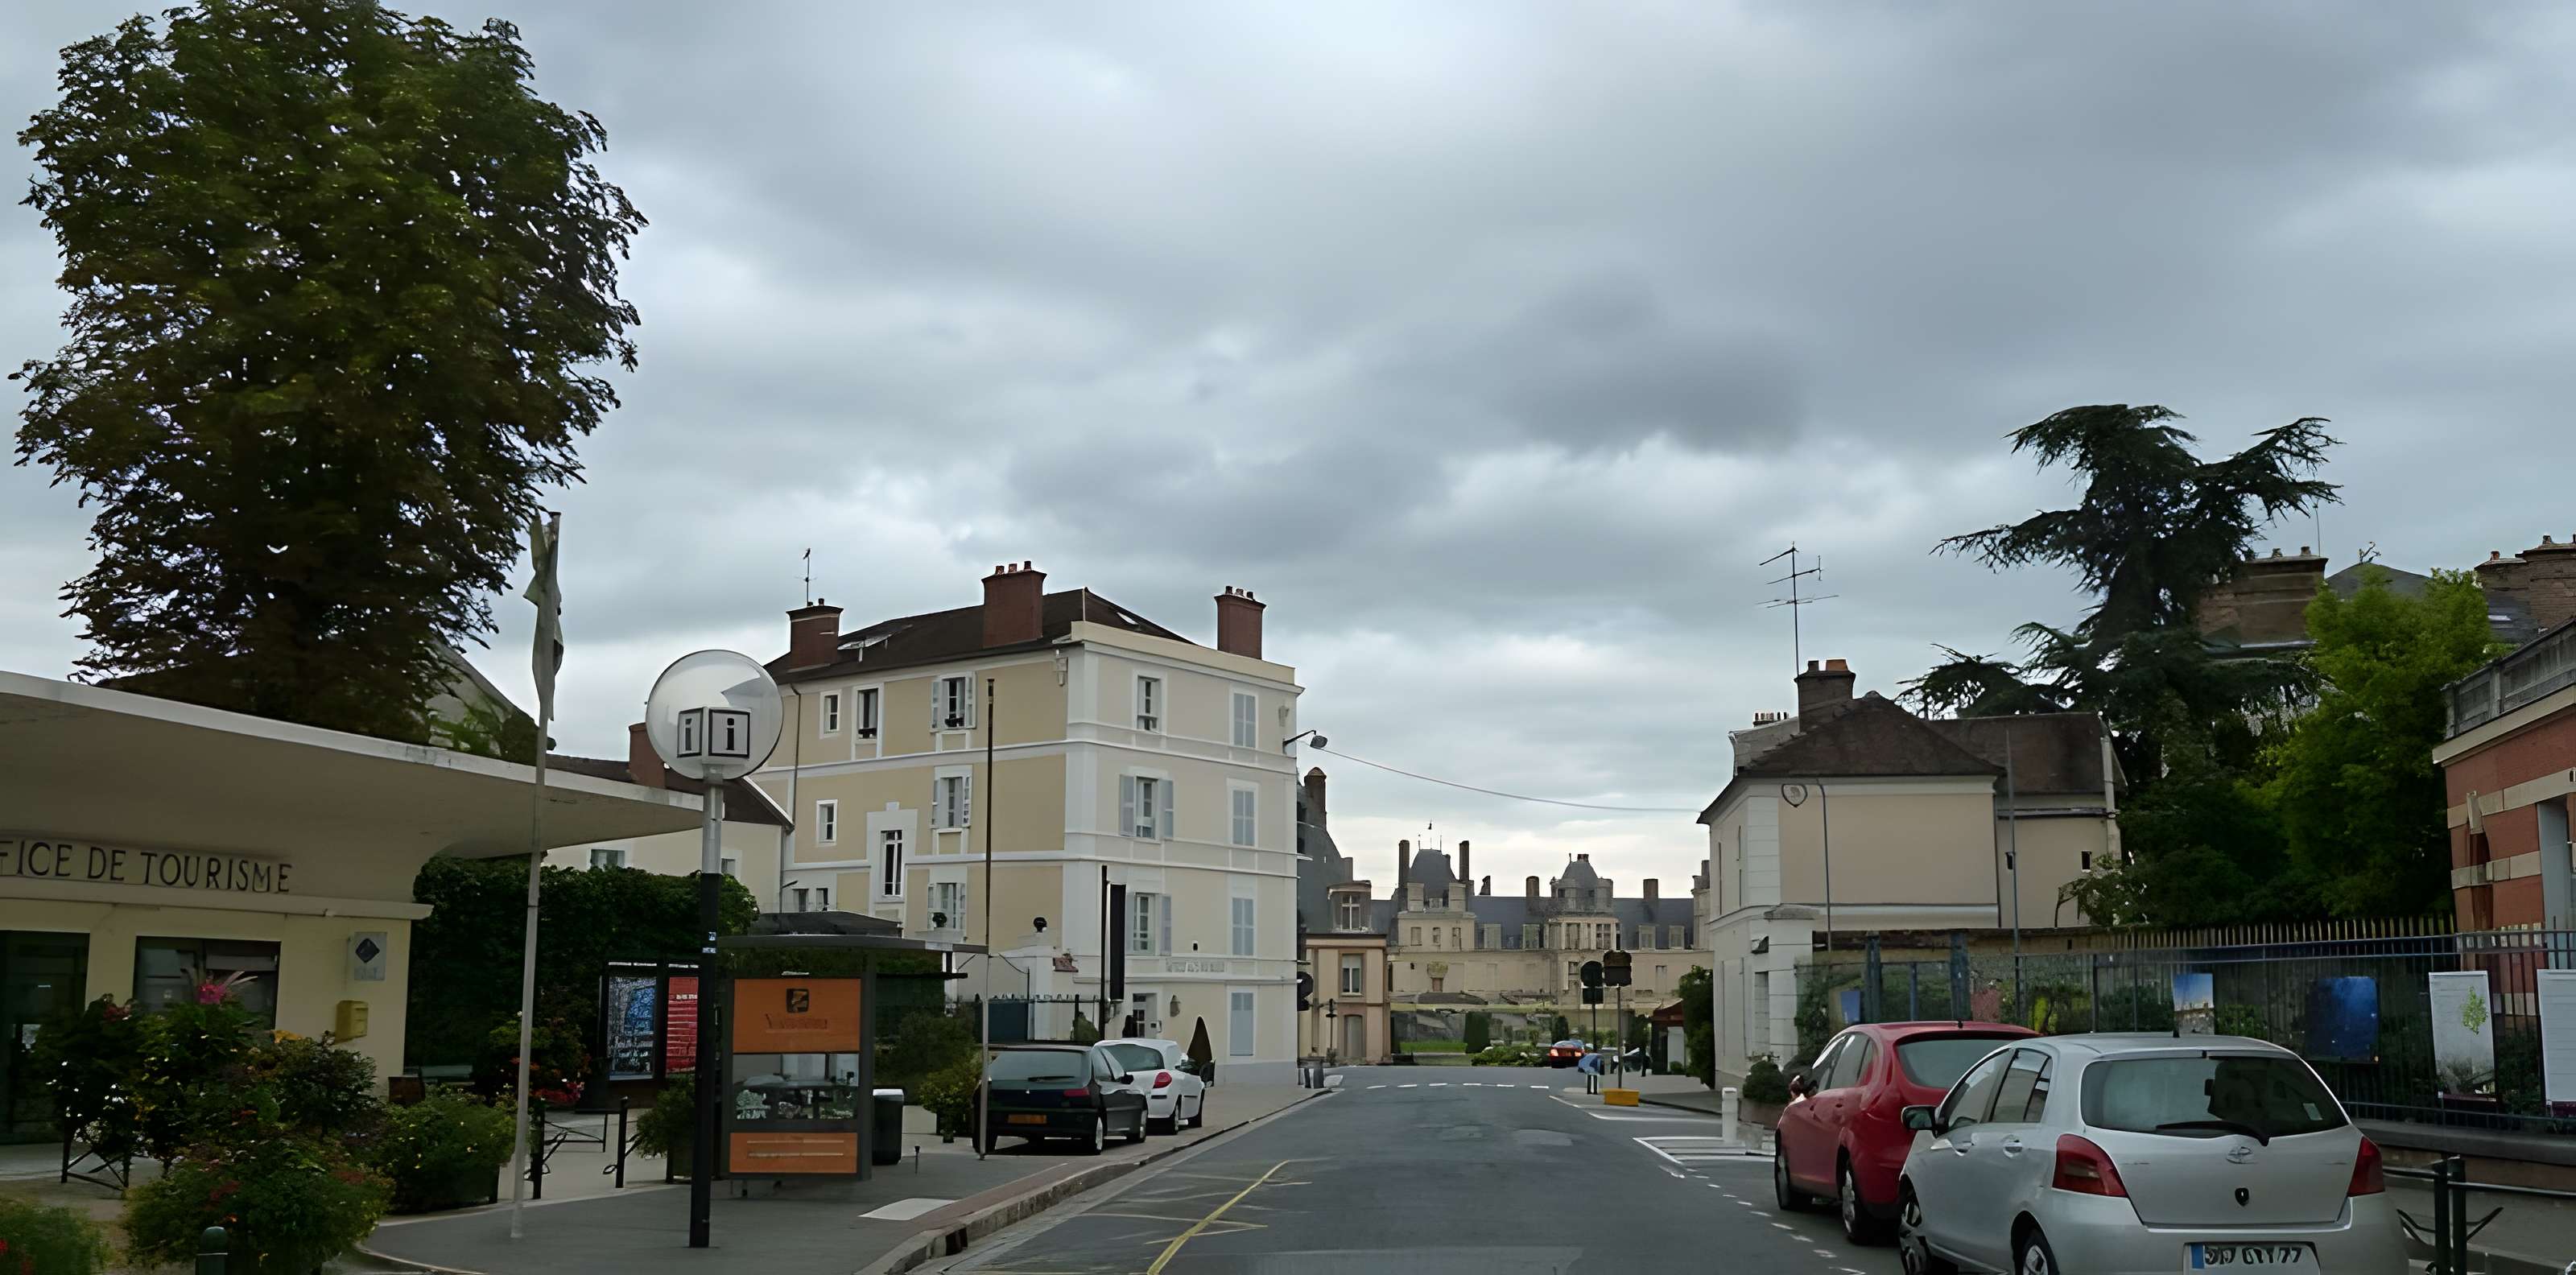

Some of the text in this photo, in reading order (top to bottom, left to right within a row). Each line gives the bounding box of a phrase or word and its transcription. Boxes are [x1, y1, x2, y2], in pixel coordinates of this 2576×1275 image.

[726, 718, 735, 751] i
[87, 846, 126, 881] DE
[140, 852, 292, 893] TOURISME
